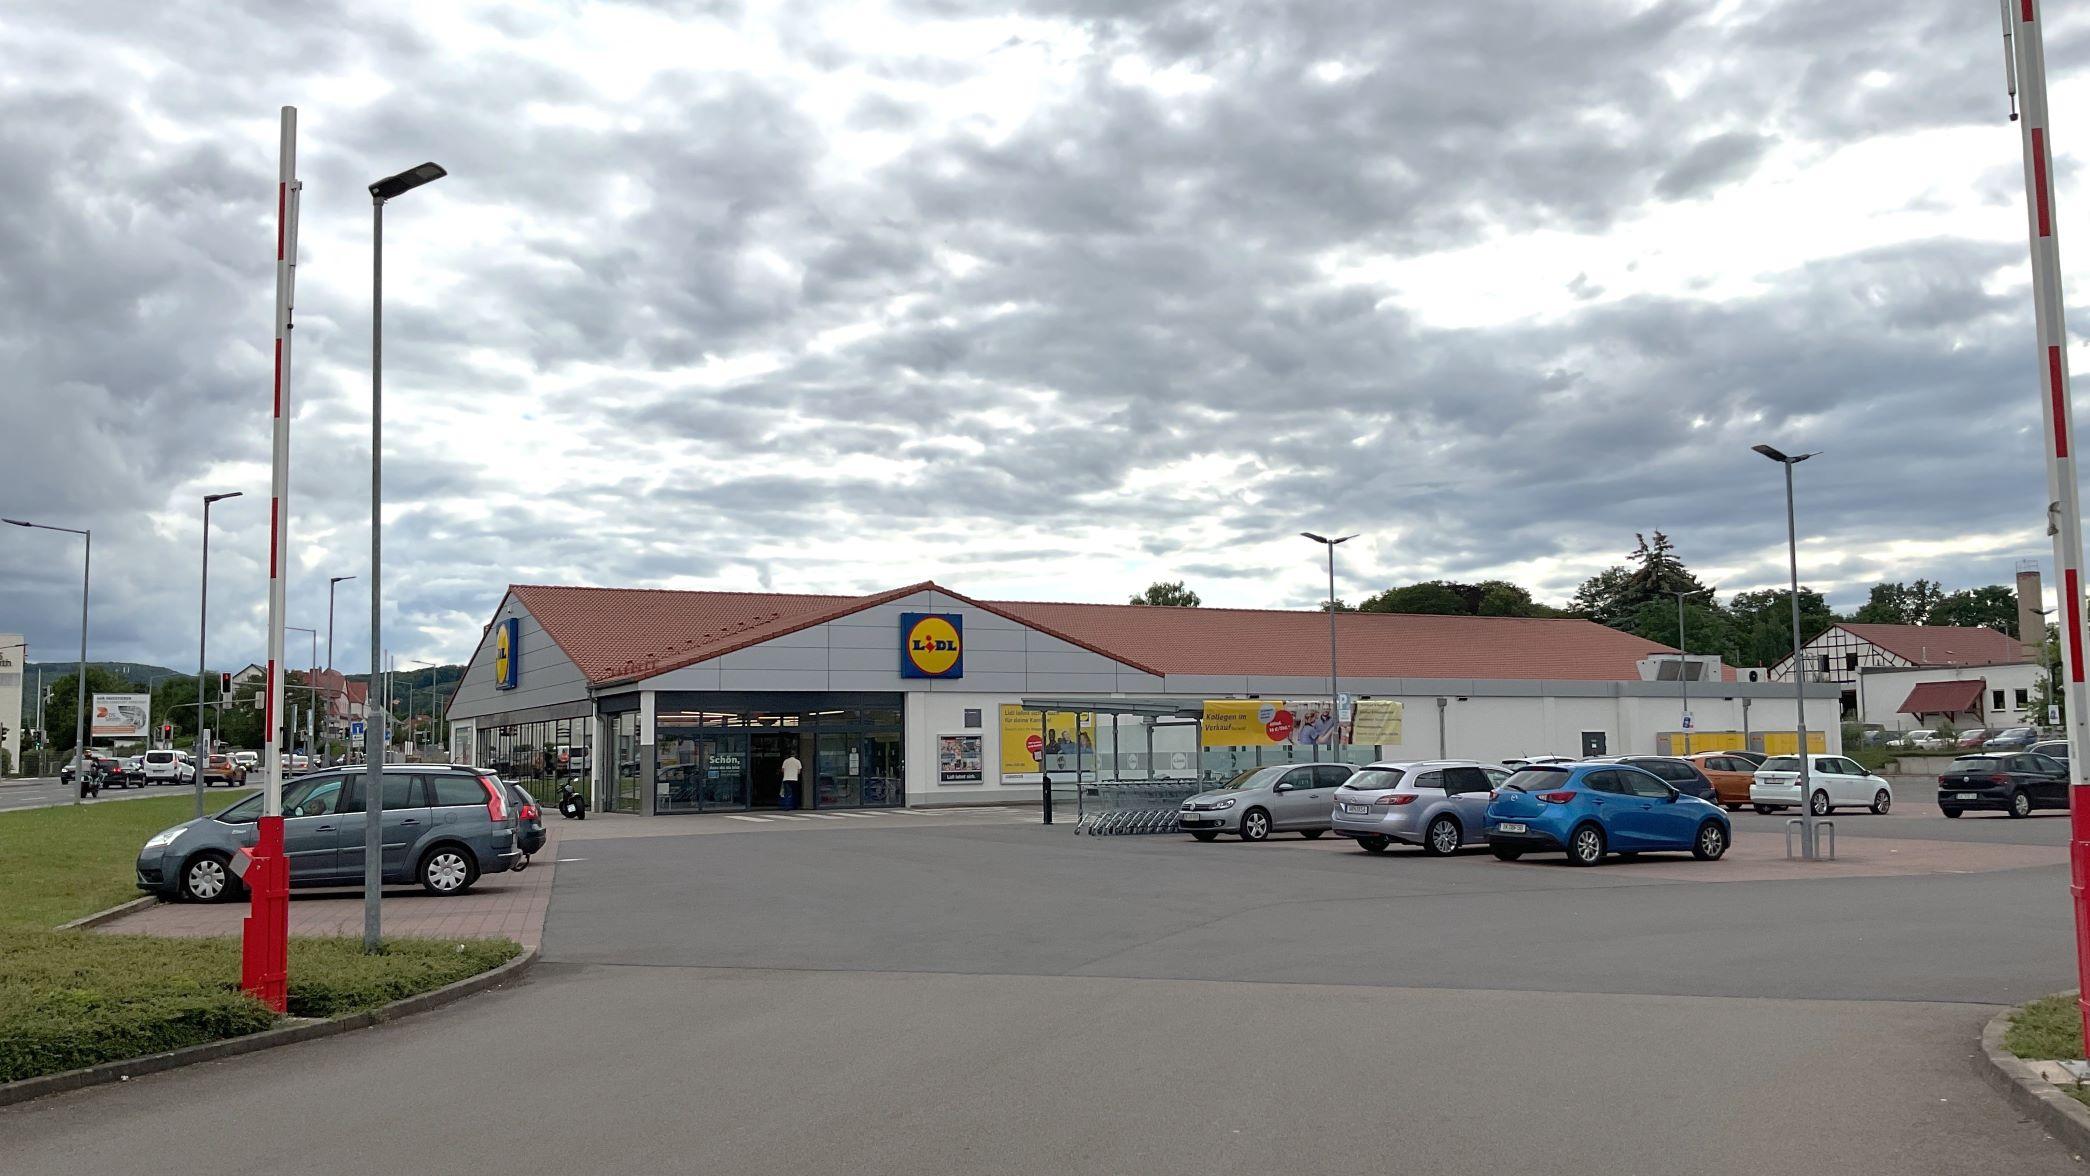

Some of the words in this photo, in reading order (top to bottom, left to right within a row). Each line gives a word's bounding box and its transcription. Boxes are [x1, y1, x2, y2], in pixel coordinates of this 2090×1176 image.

[912, 635, 957, 653] LIDL
[1340, 694, 1347, 709] P
[1206, 713, 1236, 722] Kollegen
[1205, 723, 1231, 731] Verkauf
[709, 755, 740, 764] Schön,
